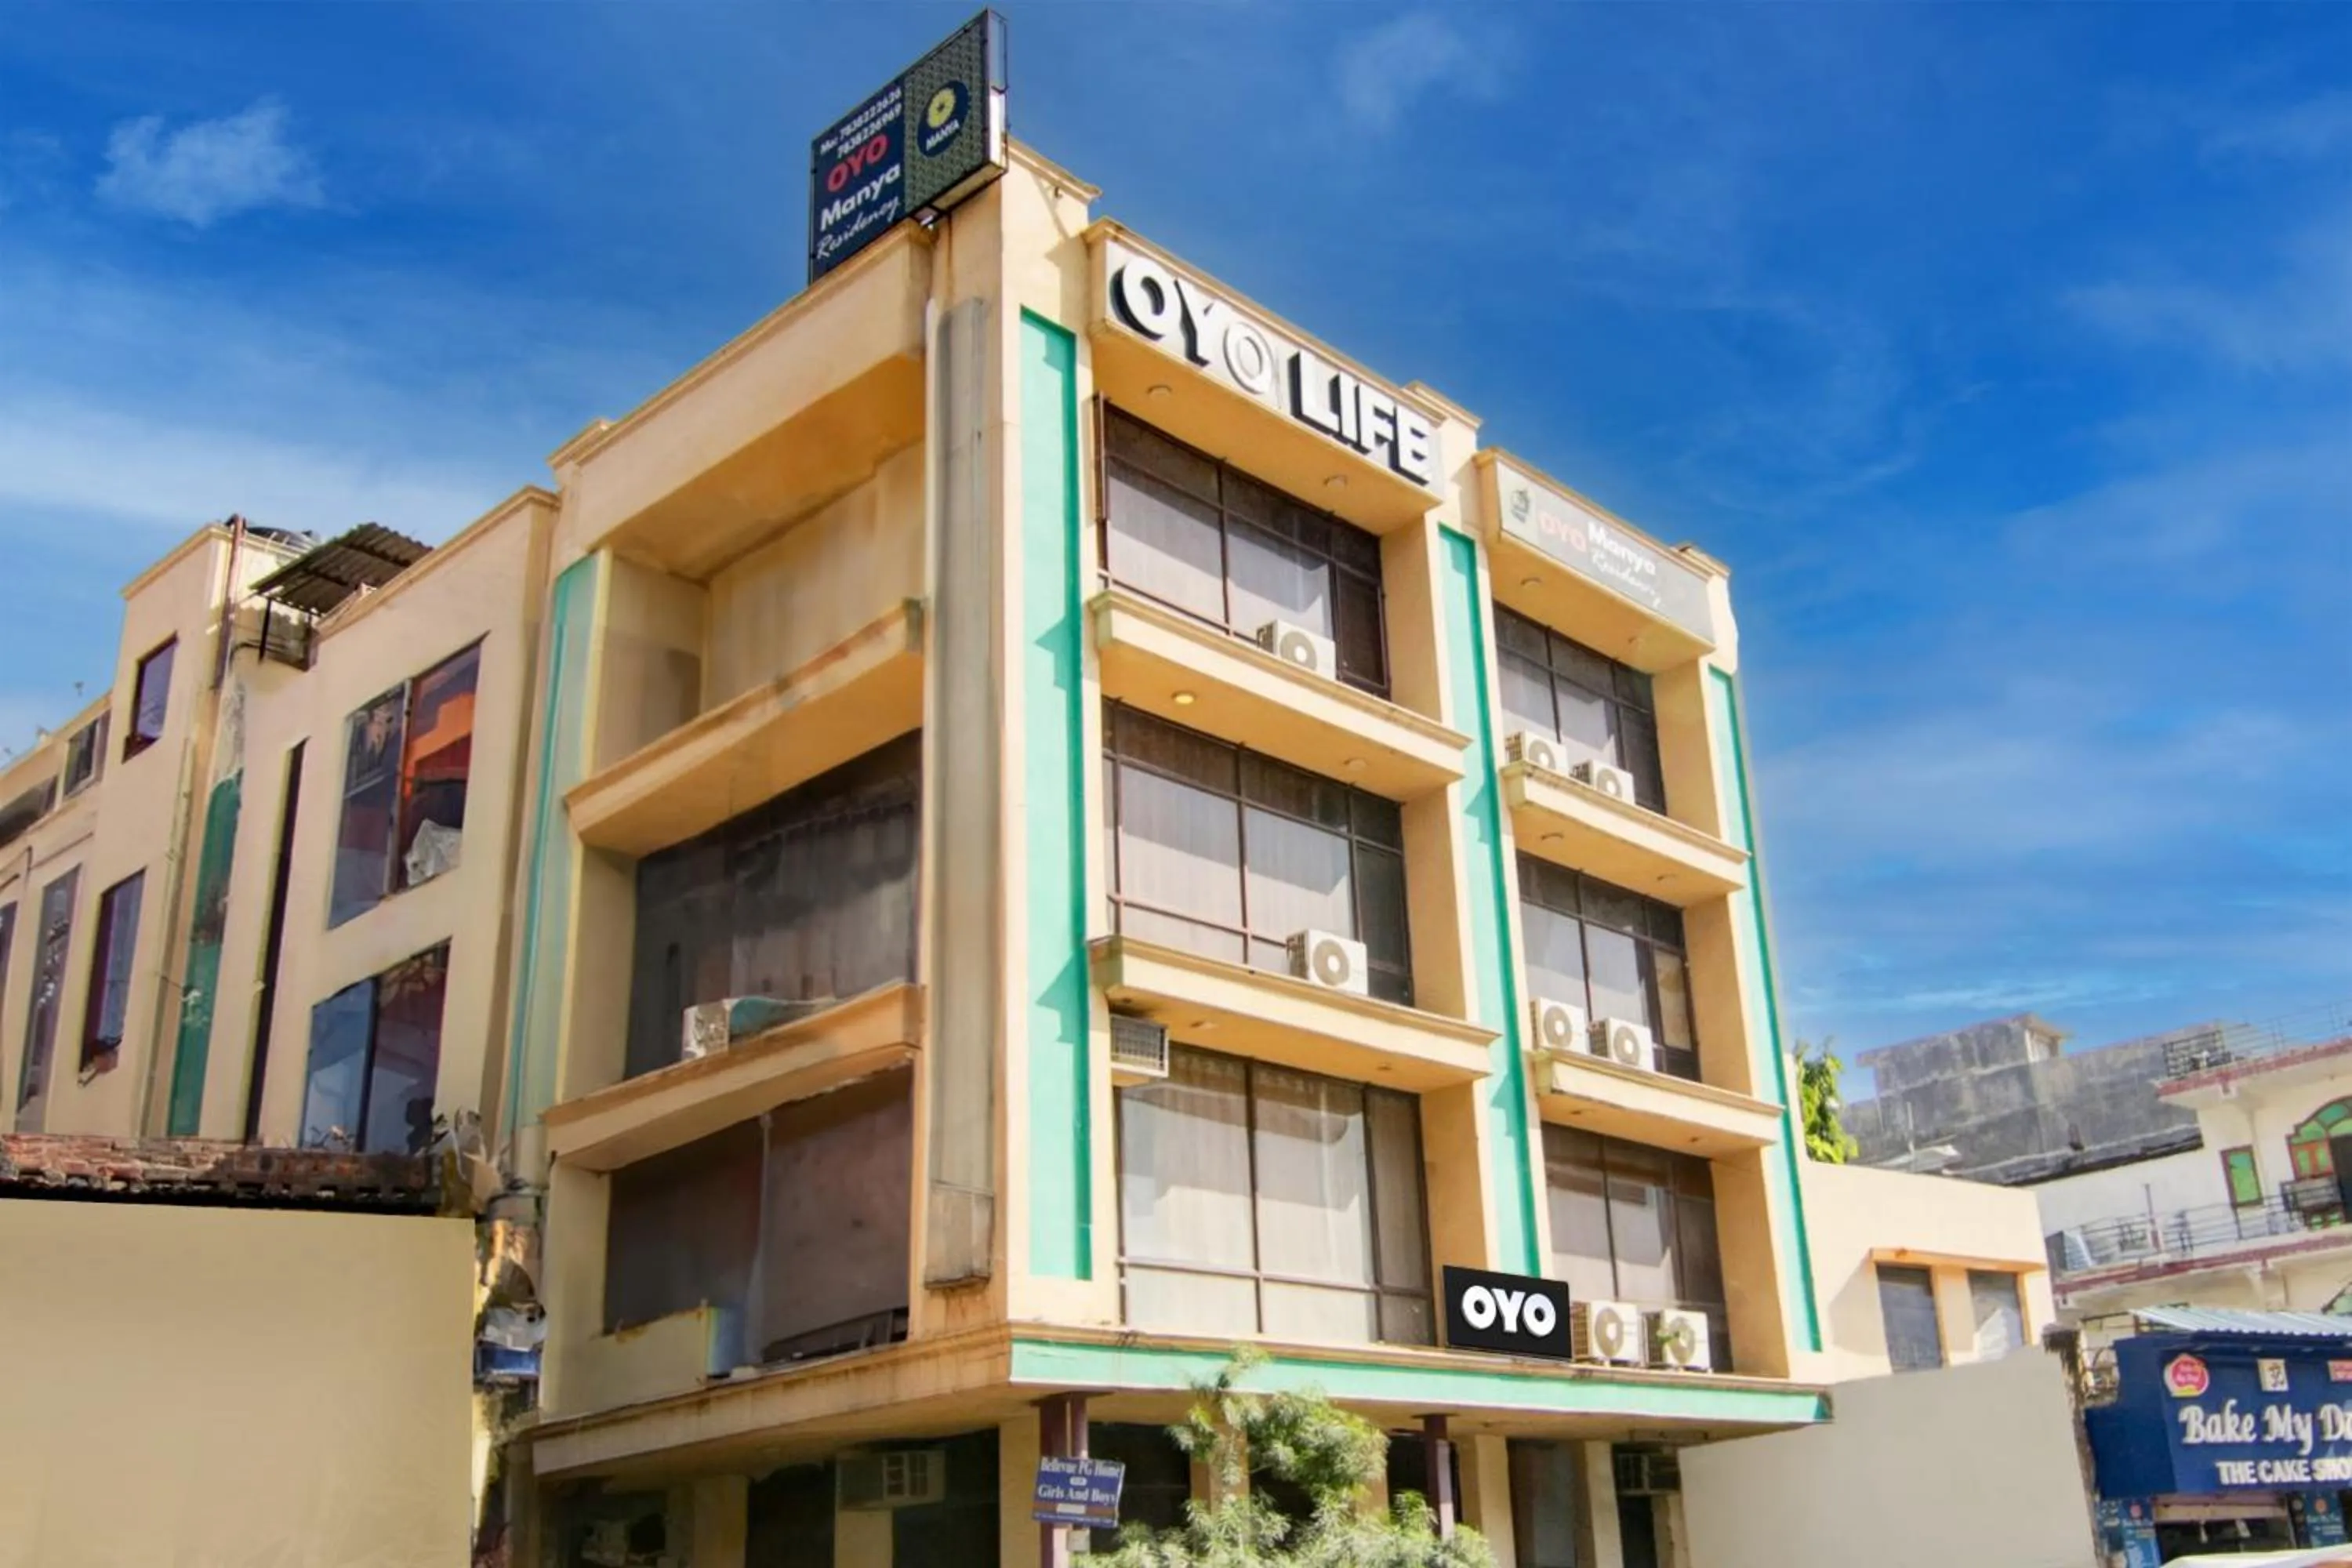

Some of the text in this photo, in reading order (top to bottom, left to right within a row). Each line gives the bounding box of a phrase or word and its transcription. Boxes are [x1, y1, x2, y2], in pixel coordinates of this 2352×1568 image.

[828, 133, 889, 192] OYO
[820, 163, 901, 231] Manya
[1109, 256, 1433, 486] OYO LIFE
[1538, 510, 1656, 575] OYO Manya
[1461, 1285, 1556, 1338] OYO
[2178, 1399, 2257, 1444] Bake
[2262, 1403, 2313, 1455] My
[1038, 1484, 1115, 1505] Girls And Boys
[2215, 1461, 2257, 1484] THE
[2258, 1460, 2312, 1483] CAKE
